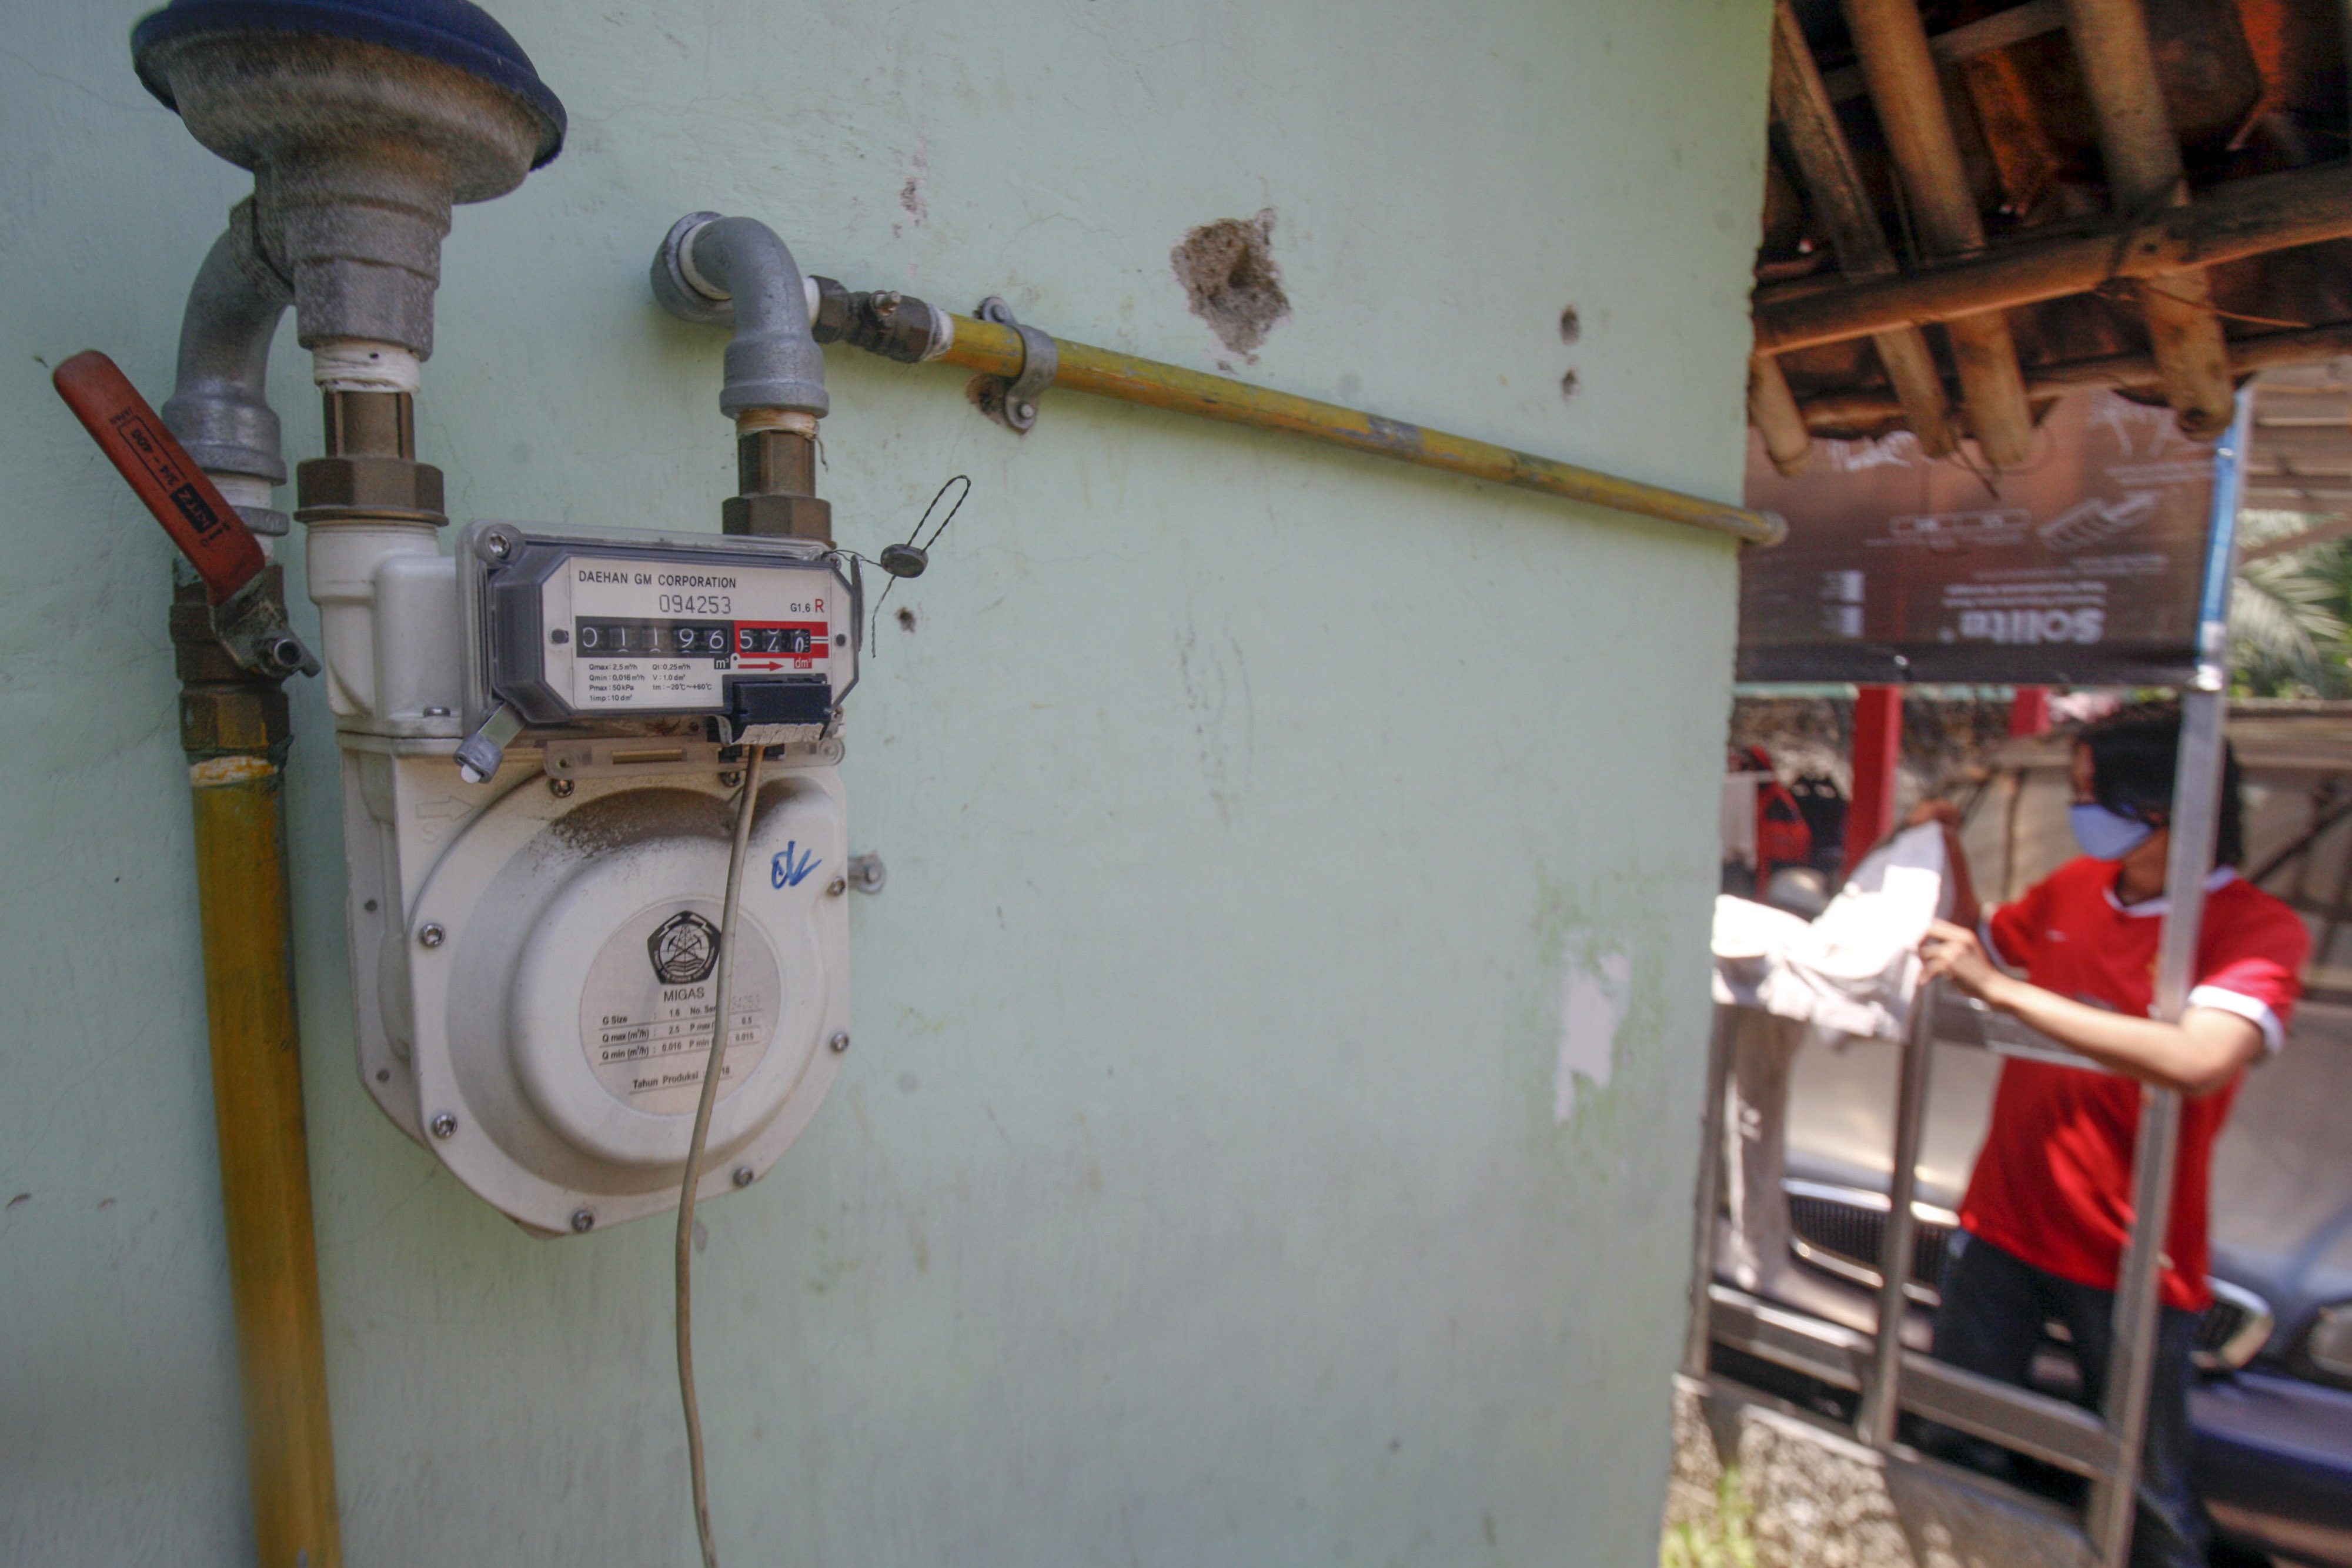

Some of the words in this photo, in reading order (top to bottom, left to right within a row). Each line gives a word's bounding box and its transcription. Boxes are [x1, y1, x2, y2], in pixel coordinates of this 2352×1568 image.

[131, 429, 153, 453] 400
[159, 464, 179, 486] 3/4
[176, 487, 211, 529] KITZ
[579, 570, 629, 584] DAEHAN
[634, 573, 652, 586] GM
[658, 574, 736, 589] CORPORATION
[659, 594, 731, 614] 094253
[790, 603, 811, 613] G1.6
[815, 599, 824, 613] R
[716, 658, 730, 668] m³
[794, 657, 811, 668] dm³
[663, 987, 704, 1002] MIGAS
[603, 1016, 609, 1025] G
[611, 1014, 627, 1024] Size
[670, 1008, 680, 1018] 1.6
[690, 1006, 701, 1015] No.
[602, 1032, 609, 1042] Q
[611, 1033, 626, 1042] max
[669, 1025, 680, 1034] 2.5
[690, 1023, 695, 1032] P
[697, 1022, 710, 1031] max
[741, 1015, 752, 1025] 0.5
[602, 1051, 609, 1060] Q
[610, 1049, 626, 1059] min
[689, 1039, 694, 1049] P
[696, 1038, 710, 1047] min
[632, 1078, 658, 1089] Tahun
[663, 1071, 699, 1085] Produksi
